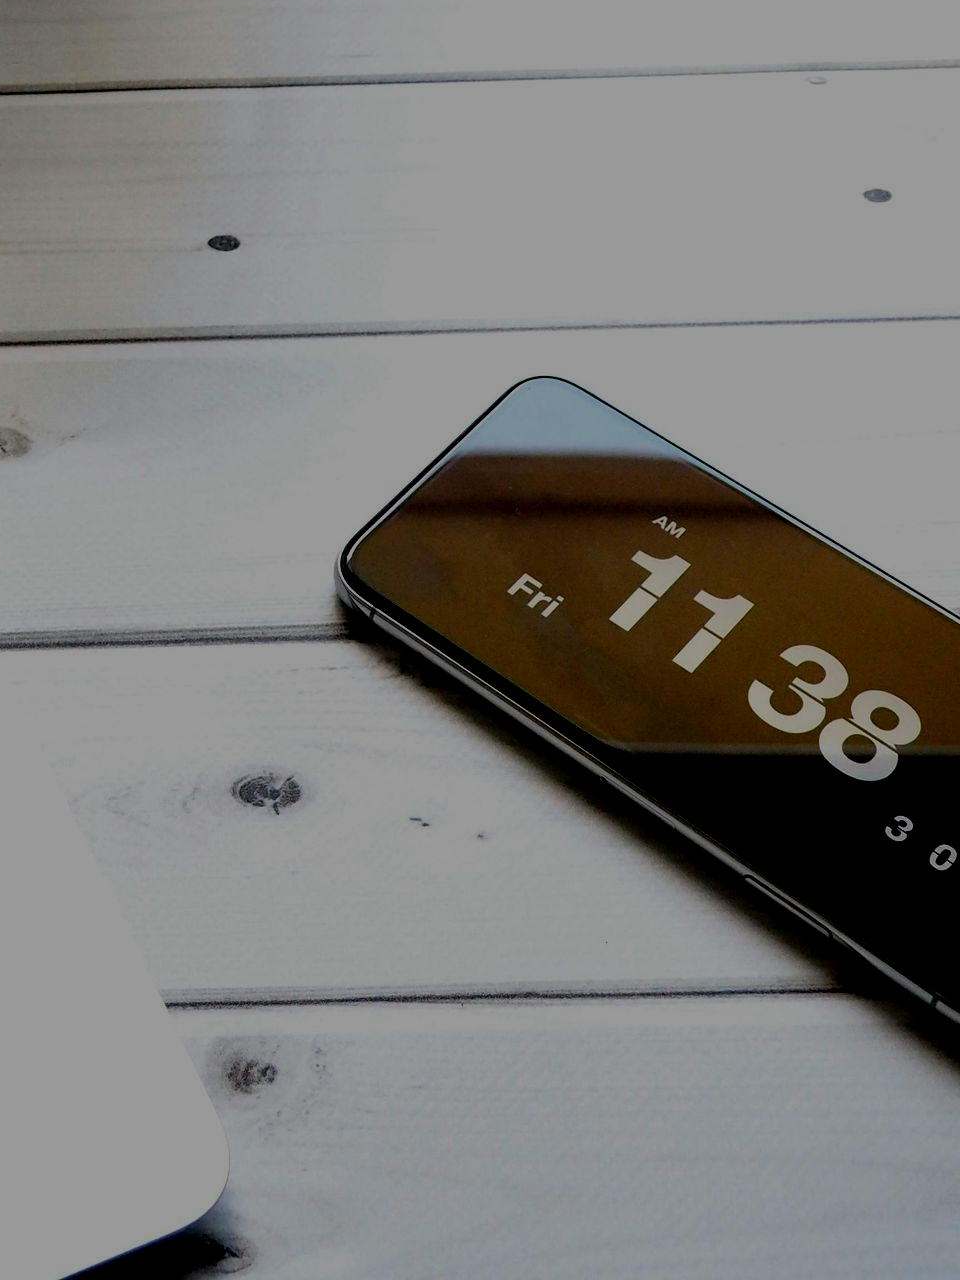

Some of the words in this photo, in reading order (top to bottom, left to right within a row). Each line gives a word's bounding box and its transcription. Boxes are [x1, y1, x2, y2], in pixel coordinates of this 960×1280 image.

[651, 515, 687, 539] AM
[506, 572, 565, 618] Fri
[746, 644, 922, 783] 38
